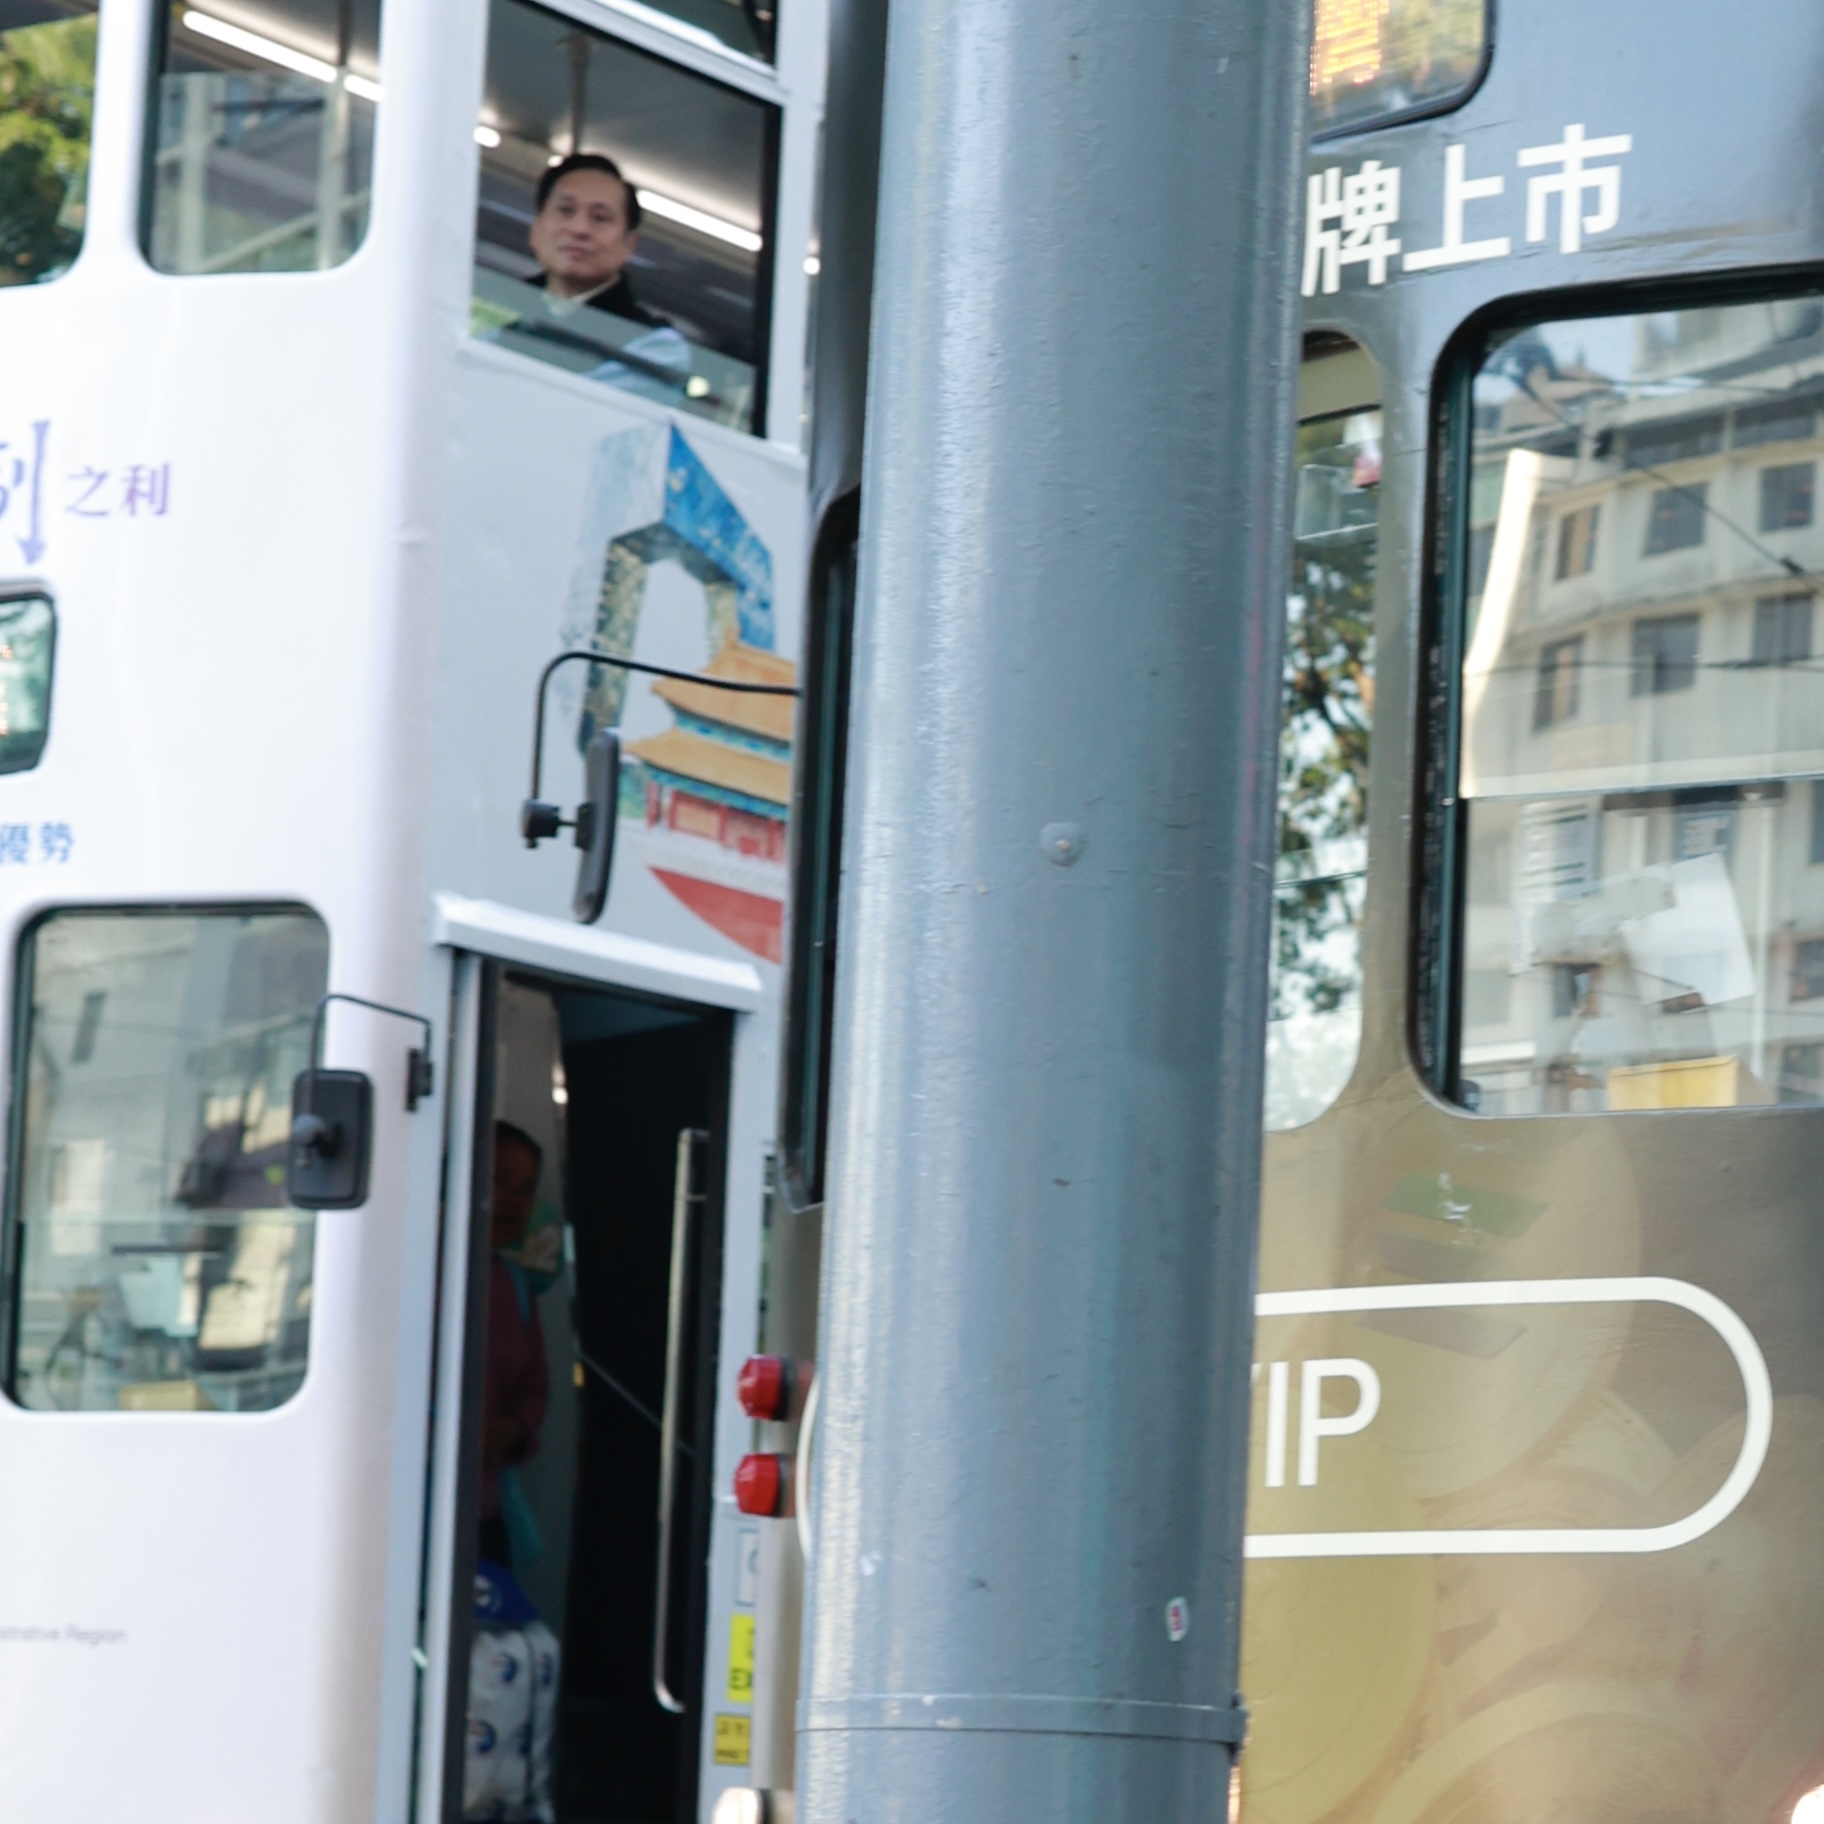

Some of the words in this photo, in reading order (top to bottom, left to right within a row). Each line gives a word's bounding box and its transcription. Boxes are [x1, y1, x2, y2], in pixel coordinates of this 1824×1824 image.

[1301, 123, 1633, 297] 牌上市
[1251, 1358, 1381, 1488] IP
